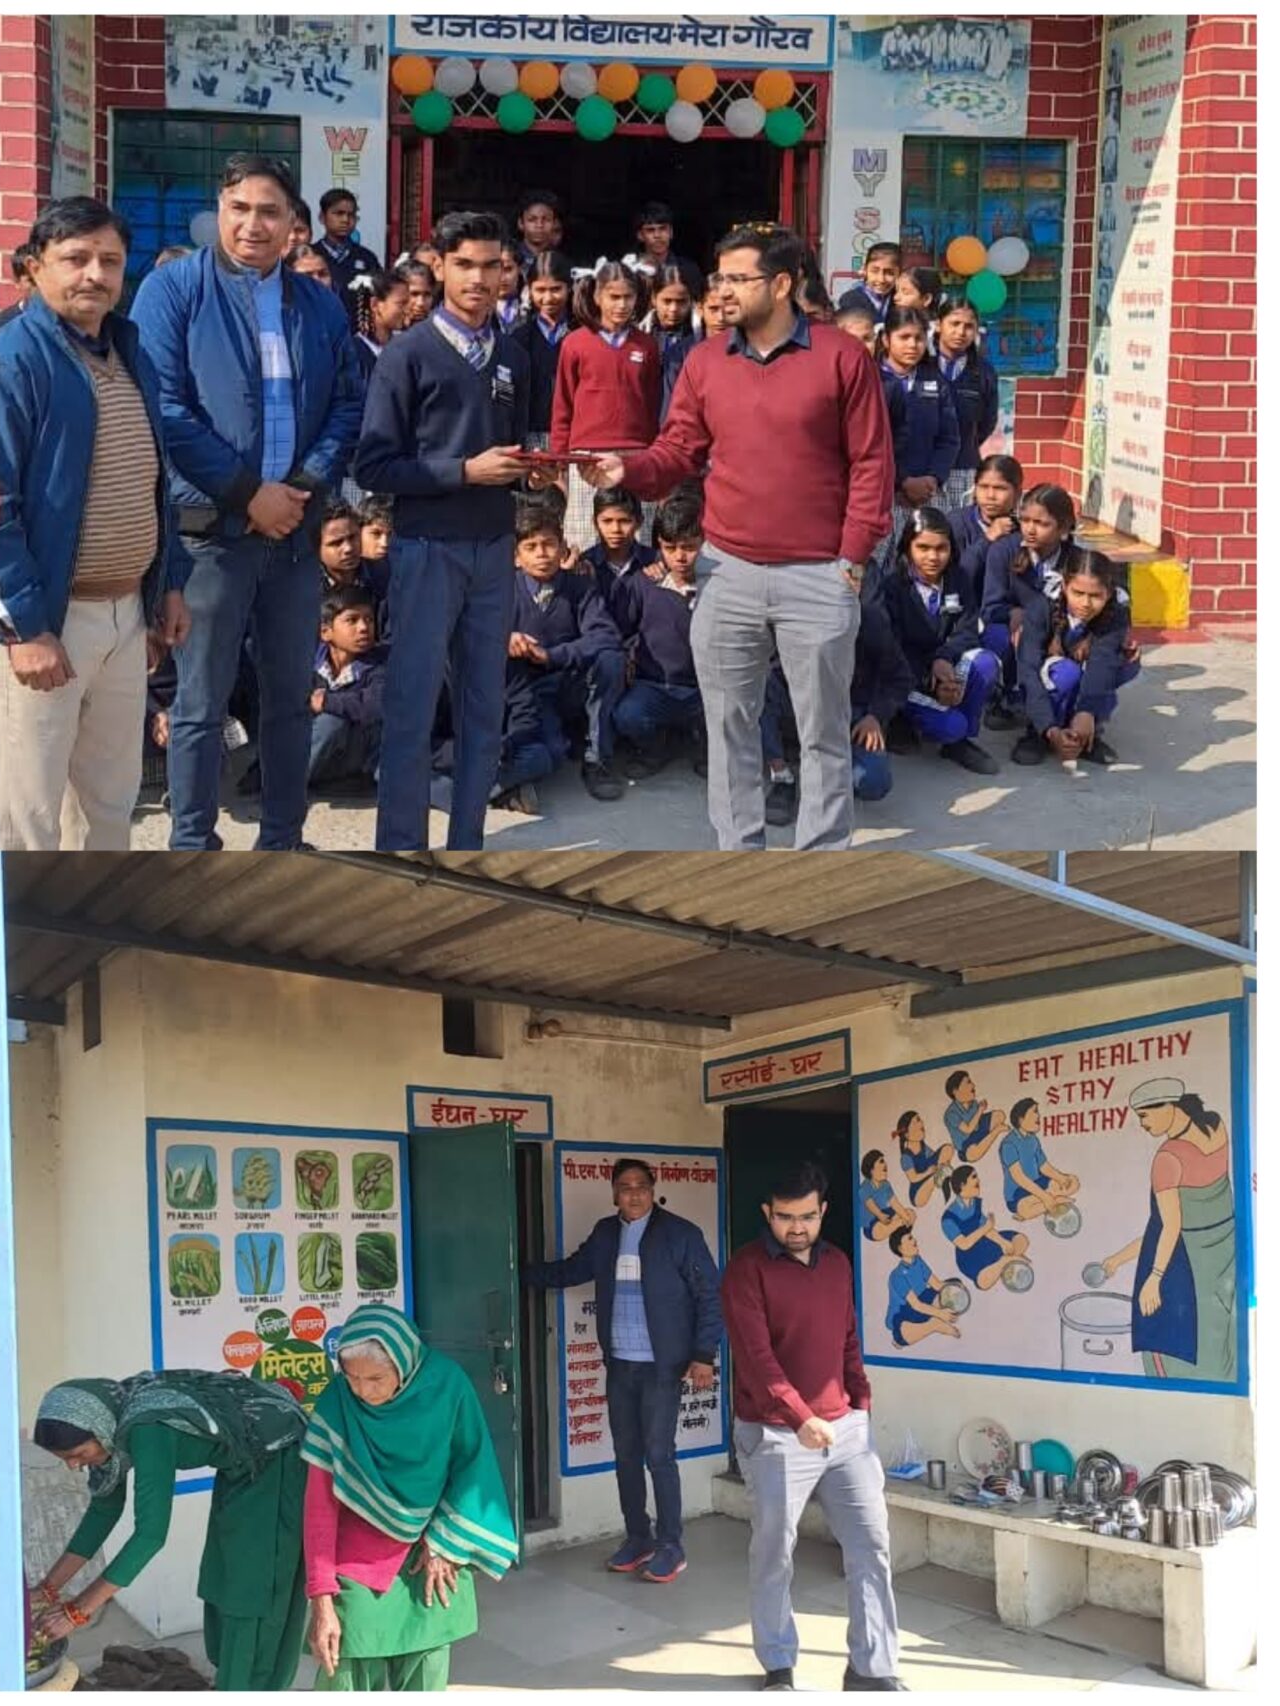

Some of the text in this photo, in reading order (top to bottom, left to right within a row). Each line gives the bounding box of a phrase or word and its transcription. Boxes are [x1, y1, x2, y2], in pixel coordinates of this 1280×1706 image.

[852, 148, 888, 197] MY
[790, 1051, 822, 1075] घर
[1018, 1030, 1192, 1083] EAT HEALTHY
[1046, 1076, 1115, 1105] STAY
[1043, 1106, 1129, 1137] HEALTHY
[261, 1347, 326, 1380] मिलेट्स
